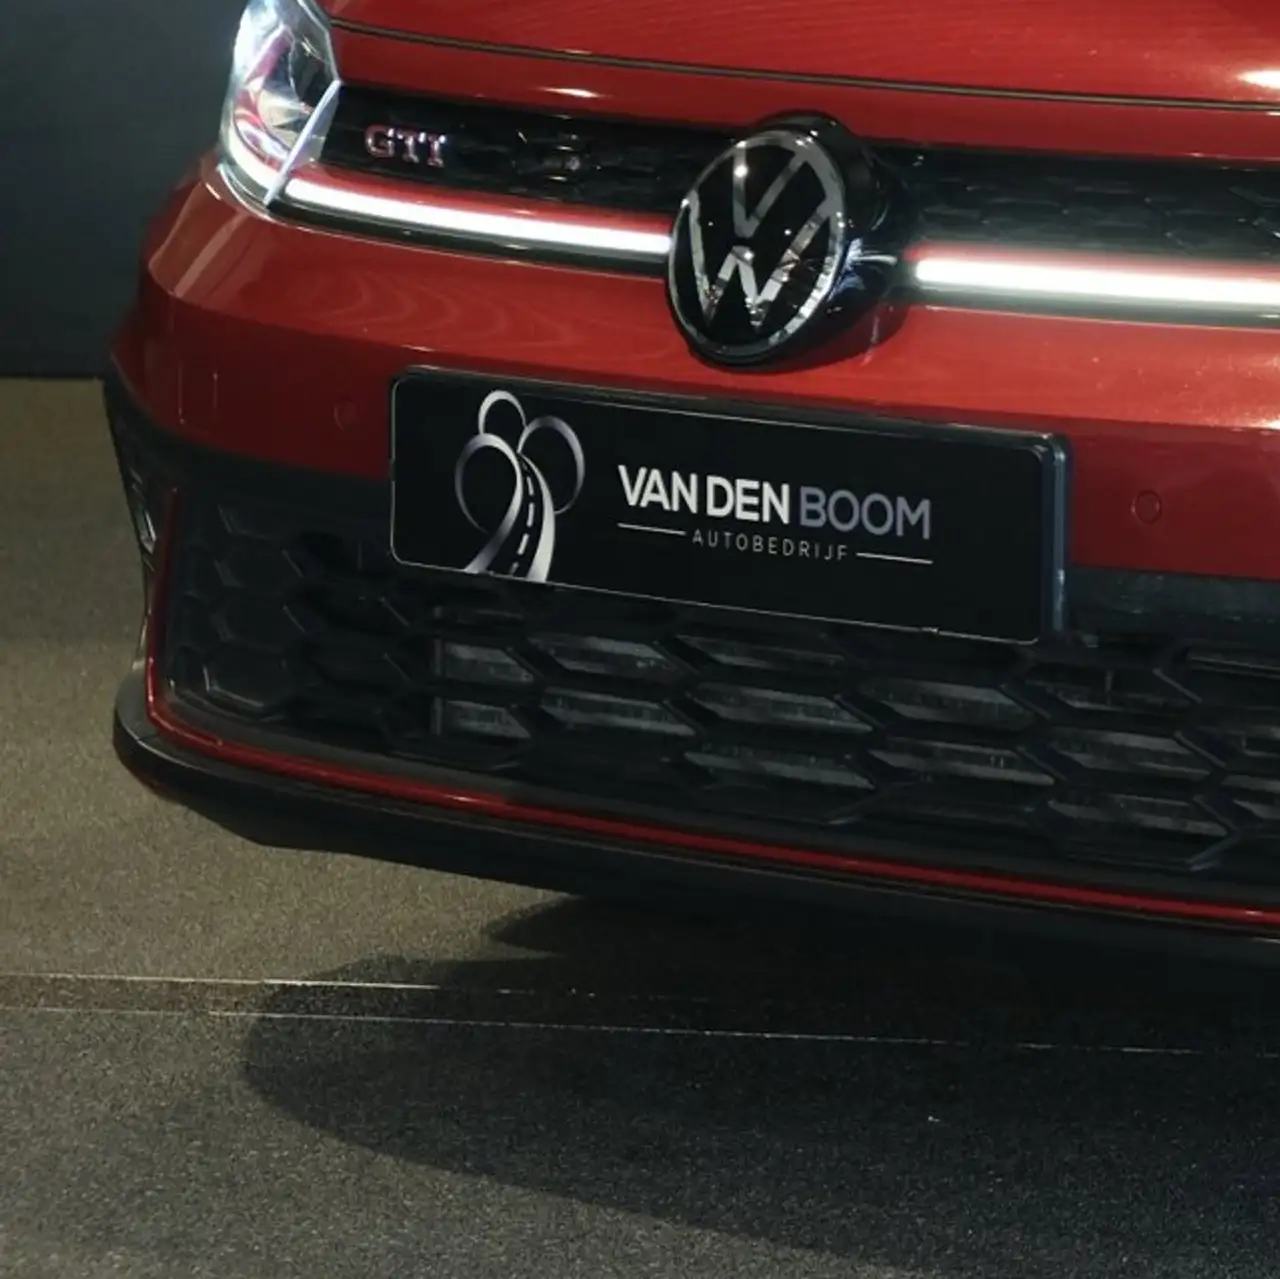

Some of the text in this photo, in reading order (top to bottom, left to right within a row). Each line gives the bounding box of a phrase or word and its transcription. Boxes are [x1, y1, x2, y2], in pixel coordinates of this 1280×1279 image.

[364, 125, 448, 168] GTI
[617, 464, 931, 540] VAN DEN BOOM
[692, 528, 849, 562] AUTOBEDRIJF
